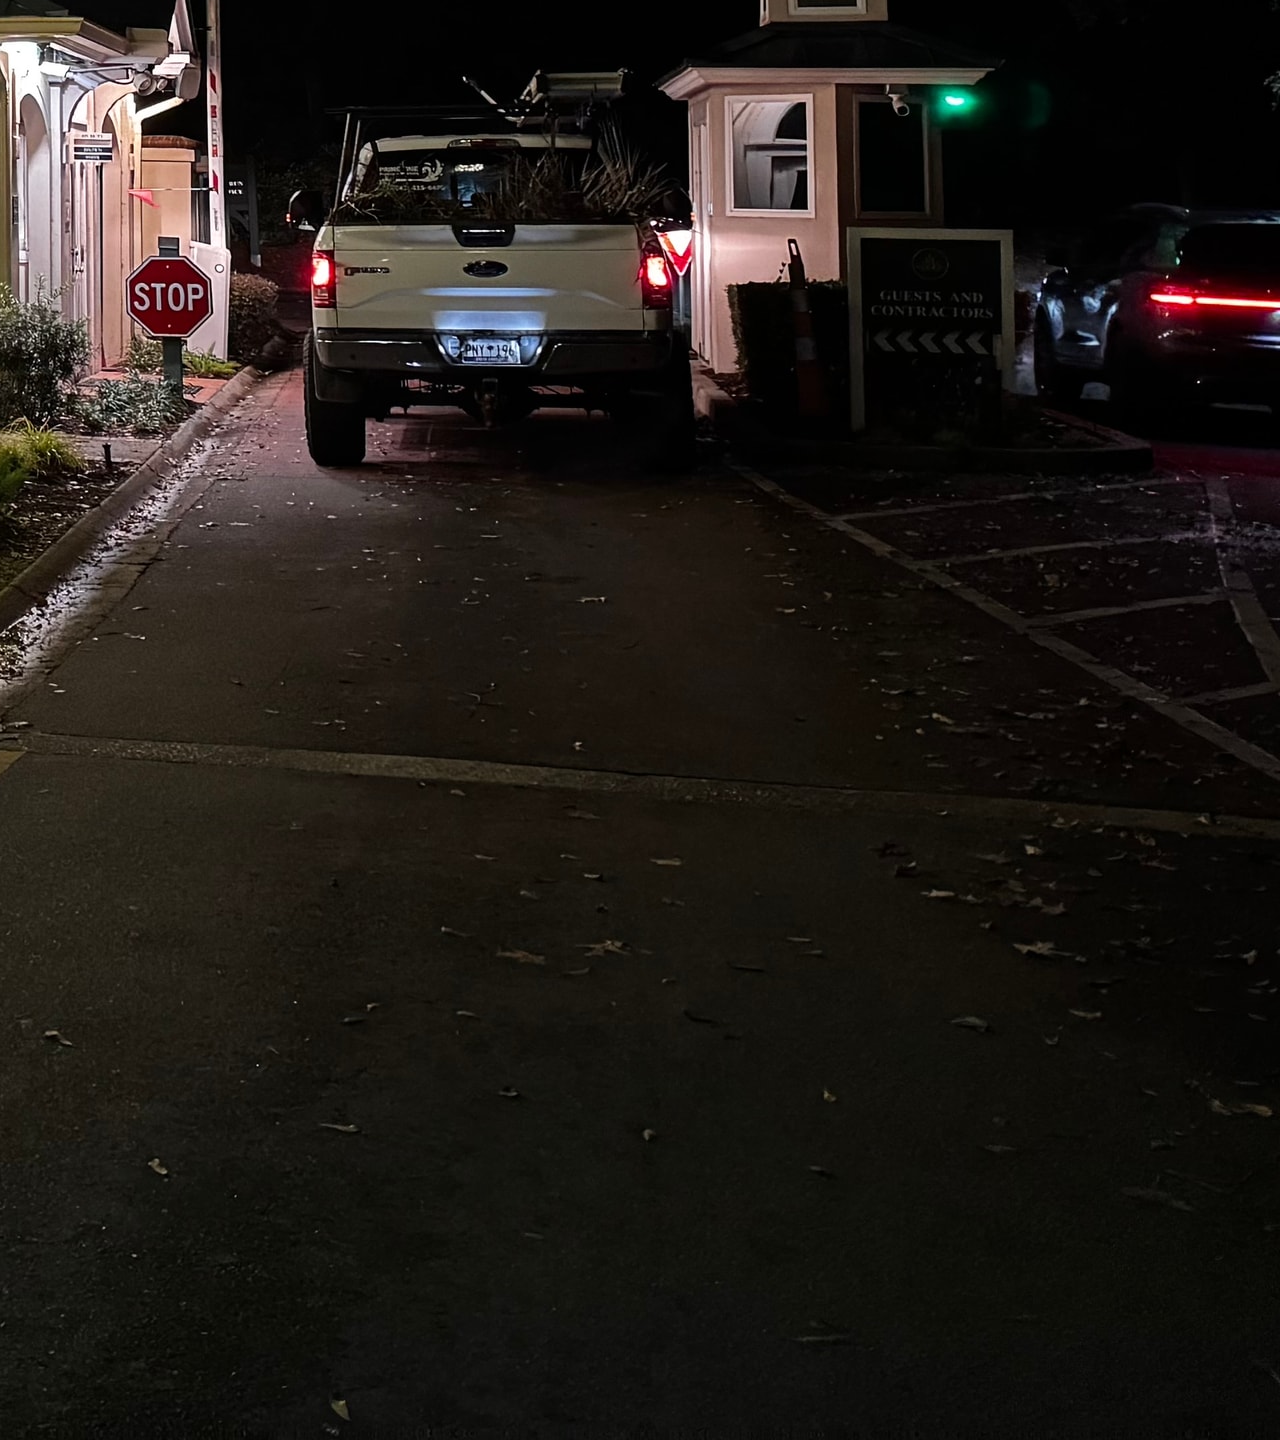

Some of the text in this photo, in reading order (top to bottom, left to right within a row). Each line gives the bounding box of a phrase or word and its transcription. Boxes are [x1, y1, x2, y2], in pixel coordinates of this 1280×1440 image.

[133, 282, 204, 311] STOP
[879, 289, 984, 303] GUESTS AND
[871, 304, 995, 319] CONTRACTORS
[465, 344, 515, 356] PNY 196
